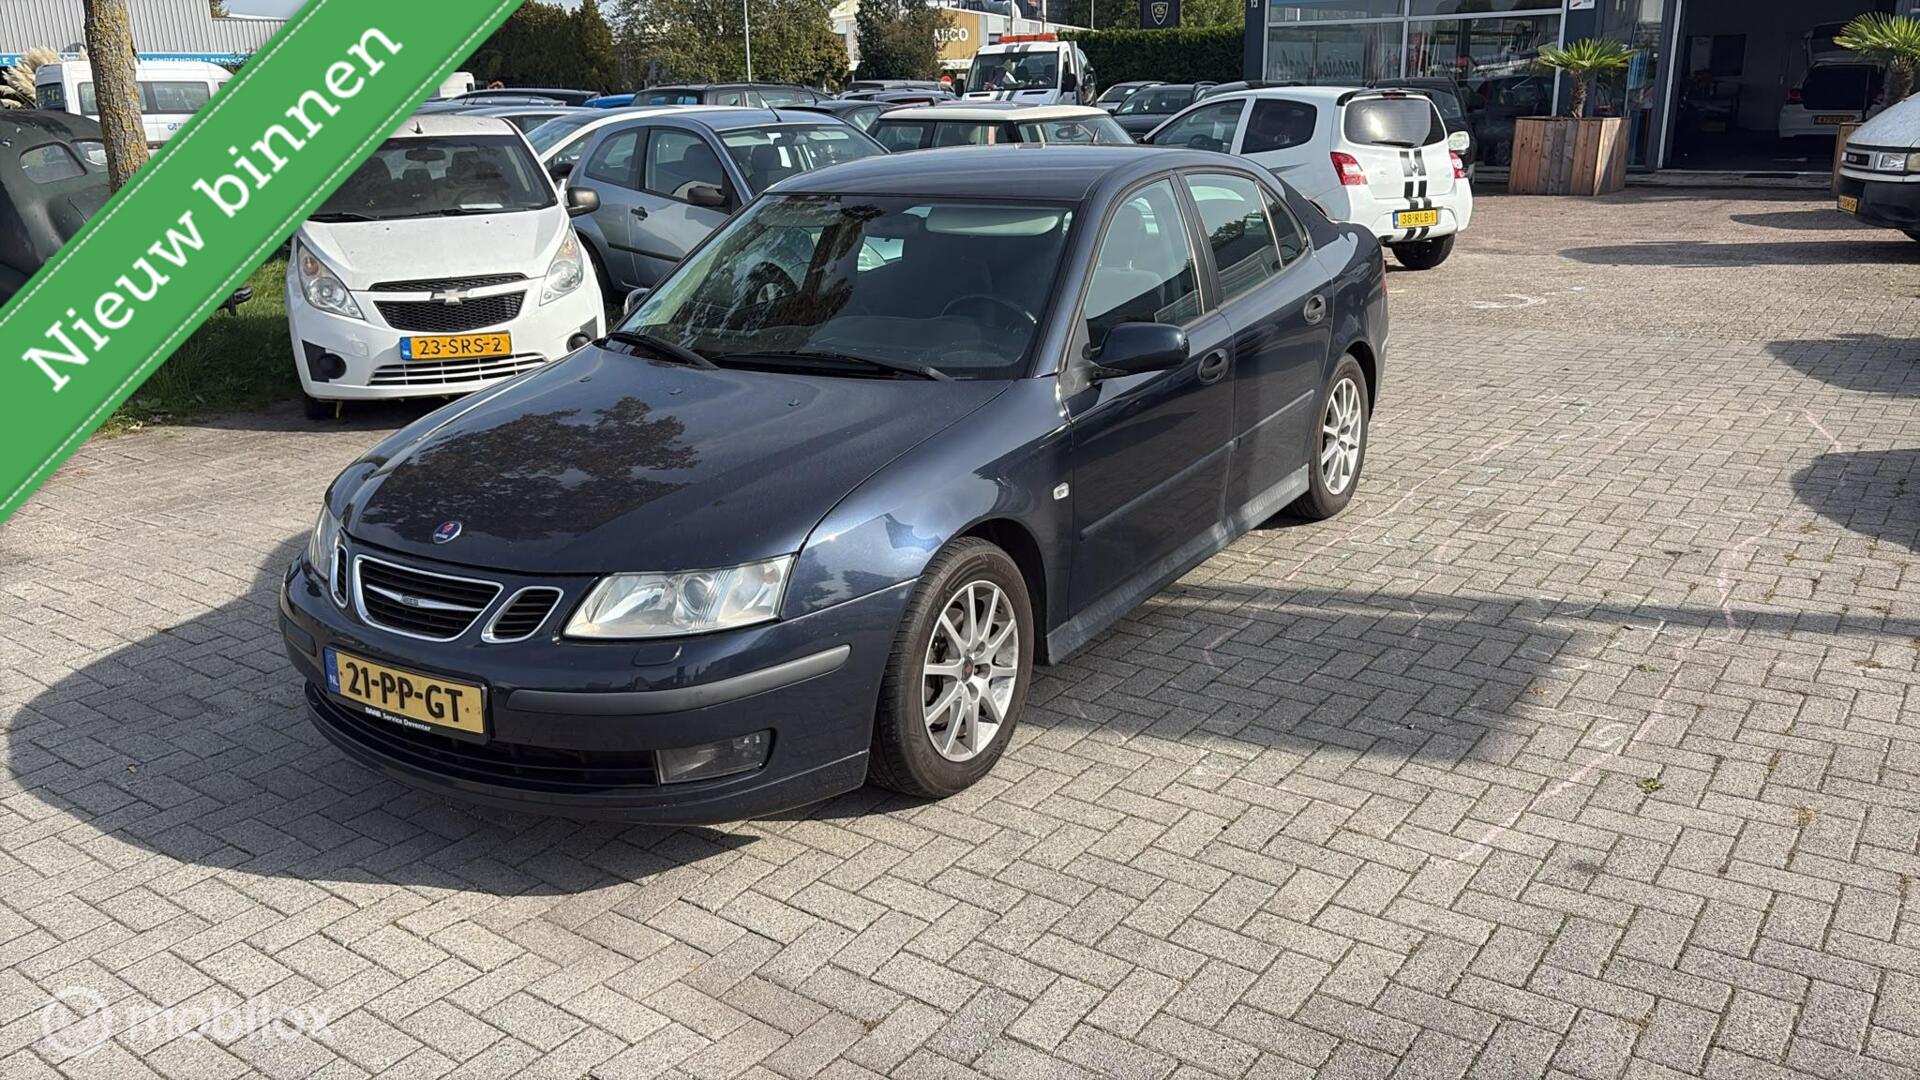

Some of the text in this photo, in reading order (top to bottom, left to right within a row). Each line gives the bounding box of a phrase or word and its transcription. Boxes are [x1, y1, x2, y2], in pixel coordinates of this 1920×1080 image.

[418, 338, 503, 355] 23-SRS-2
[329, 662, 463, 722] NL 21-PP-GT
[404, 718, 431, 731] Deventer
